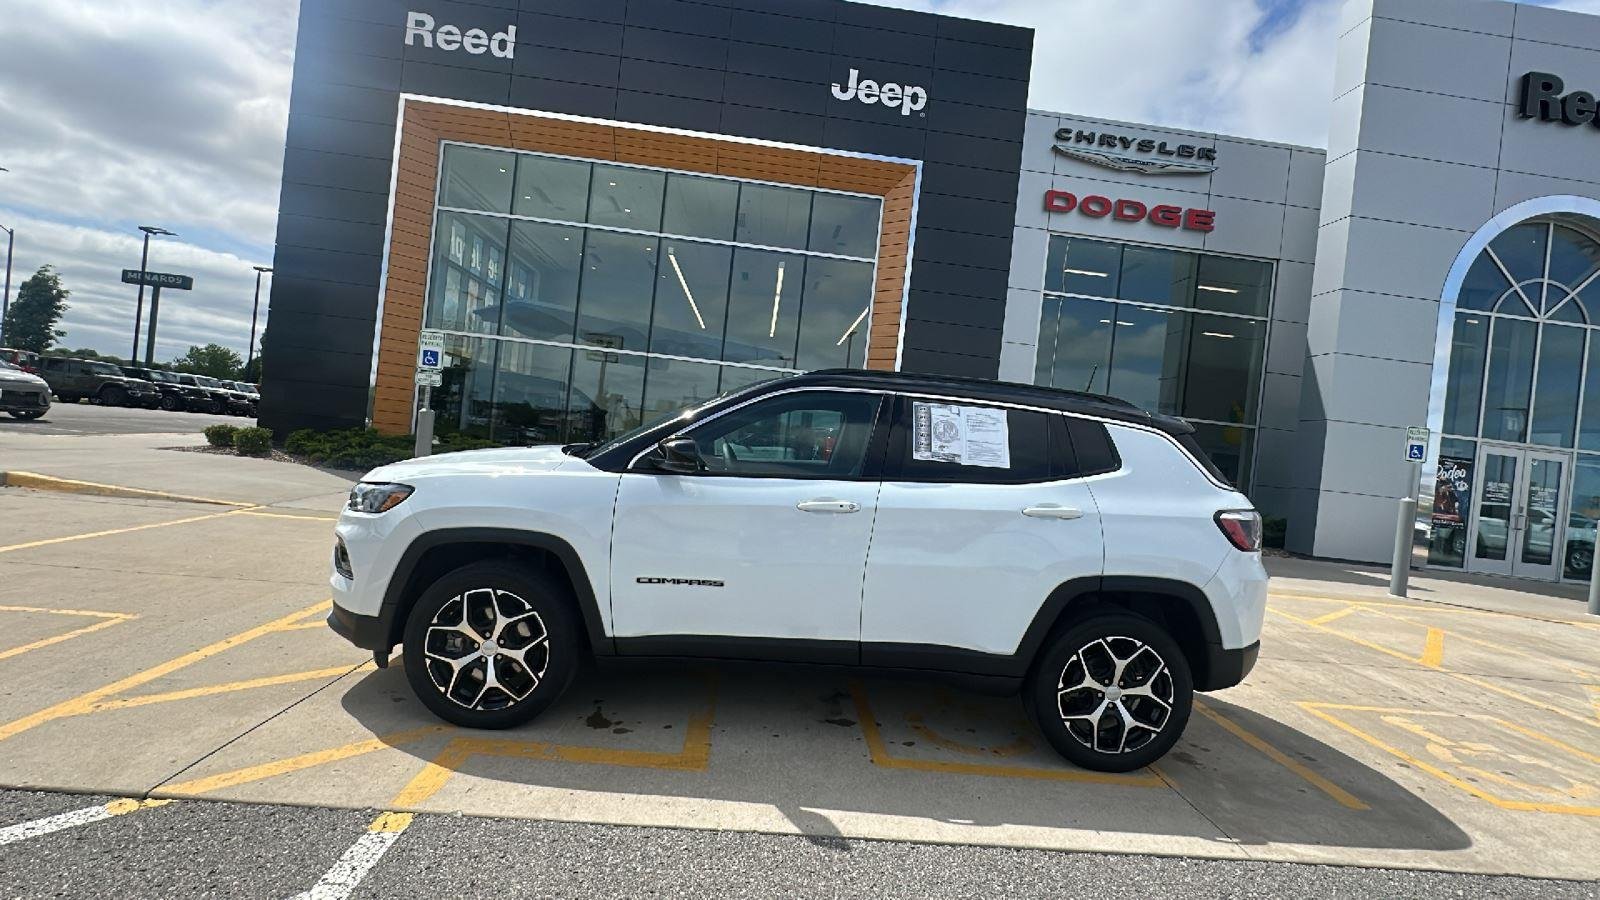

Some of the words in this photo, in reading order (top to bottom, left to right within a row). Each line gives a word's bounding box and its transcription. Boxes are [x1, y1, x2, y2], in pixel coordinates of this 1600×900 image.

[404, 11, 517, 59] Reed
[831, 68, 927, 116] Jeep
[1519, 71, 1600, 130] Re
[1055, 127, 1217, 161] CHRYSLER
[1044, 189, 1216, 232] DODGE
[636, 577, 725, 587] COMPASS
